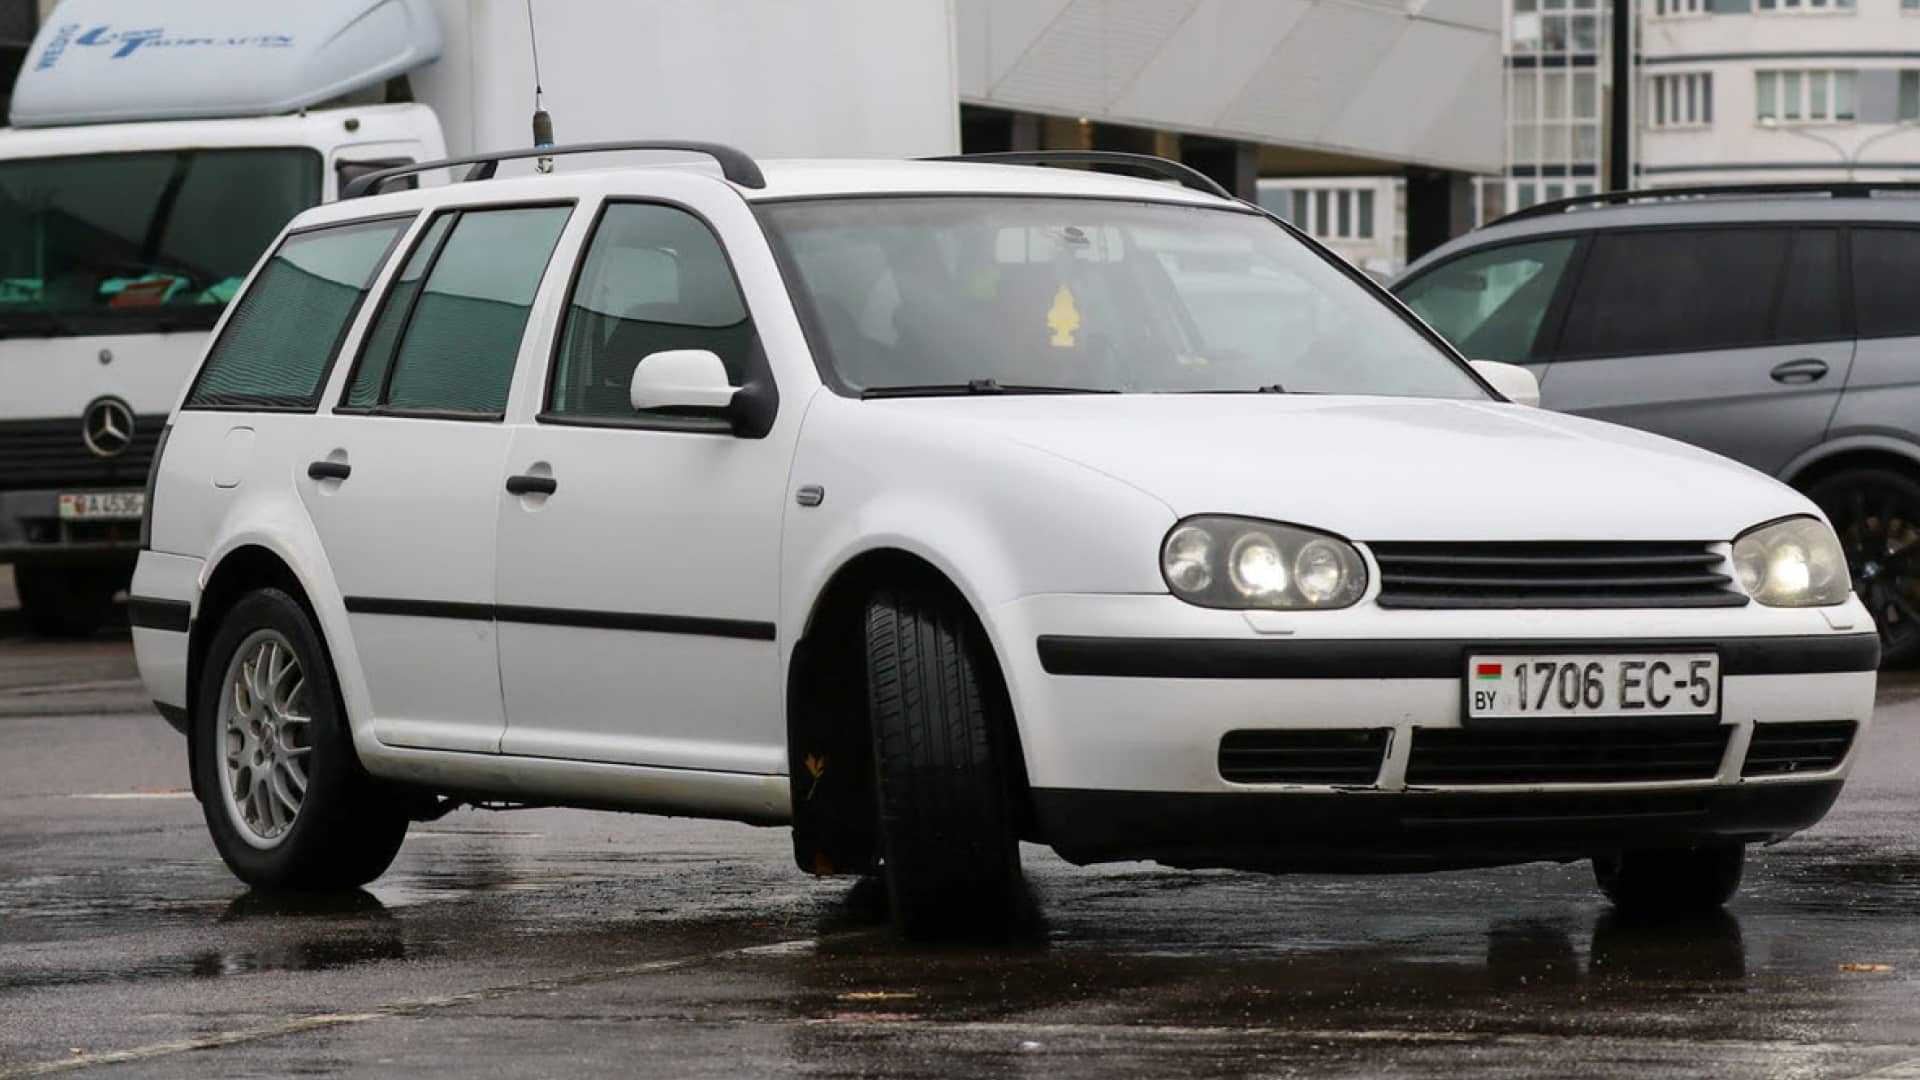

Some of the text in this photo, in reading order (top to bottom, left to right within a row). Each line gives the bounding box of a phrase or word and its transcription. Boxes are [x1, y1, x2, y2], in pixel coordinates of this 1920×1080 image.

[1475, 690, 1497, 711] BY
[1514, 660, 1712, 711] 1706 EC-5
